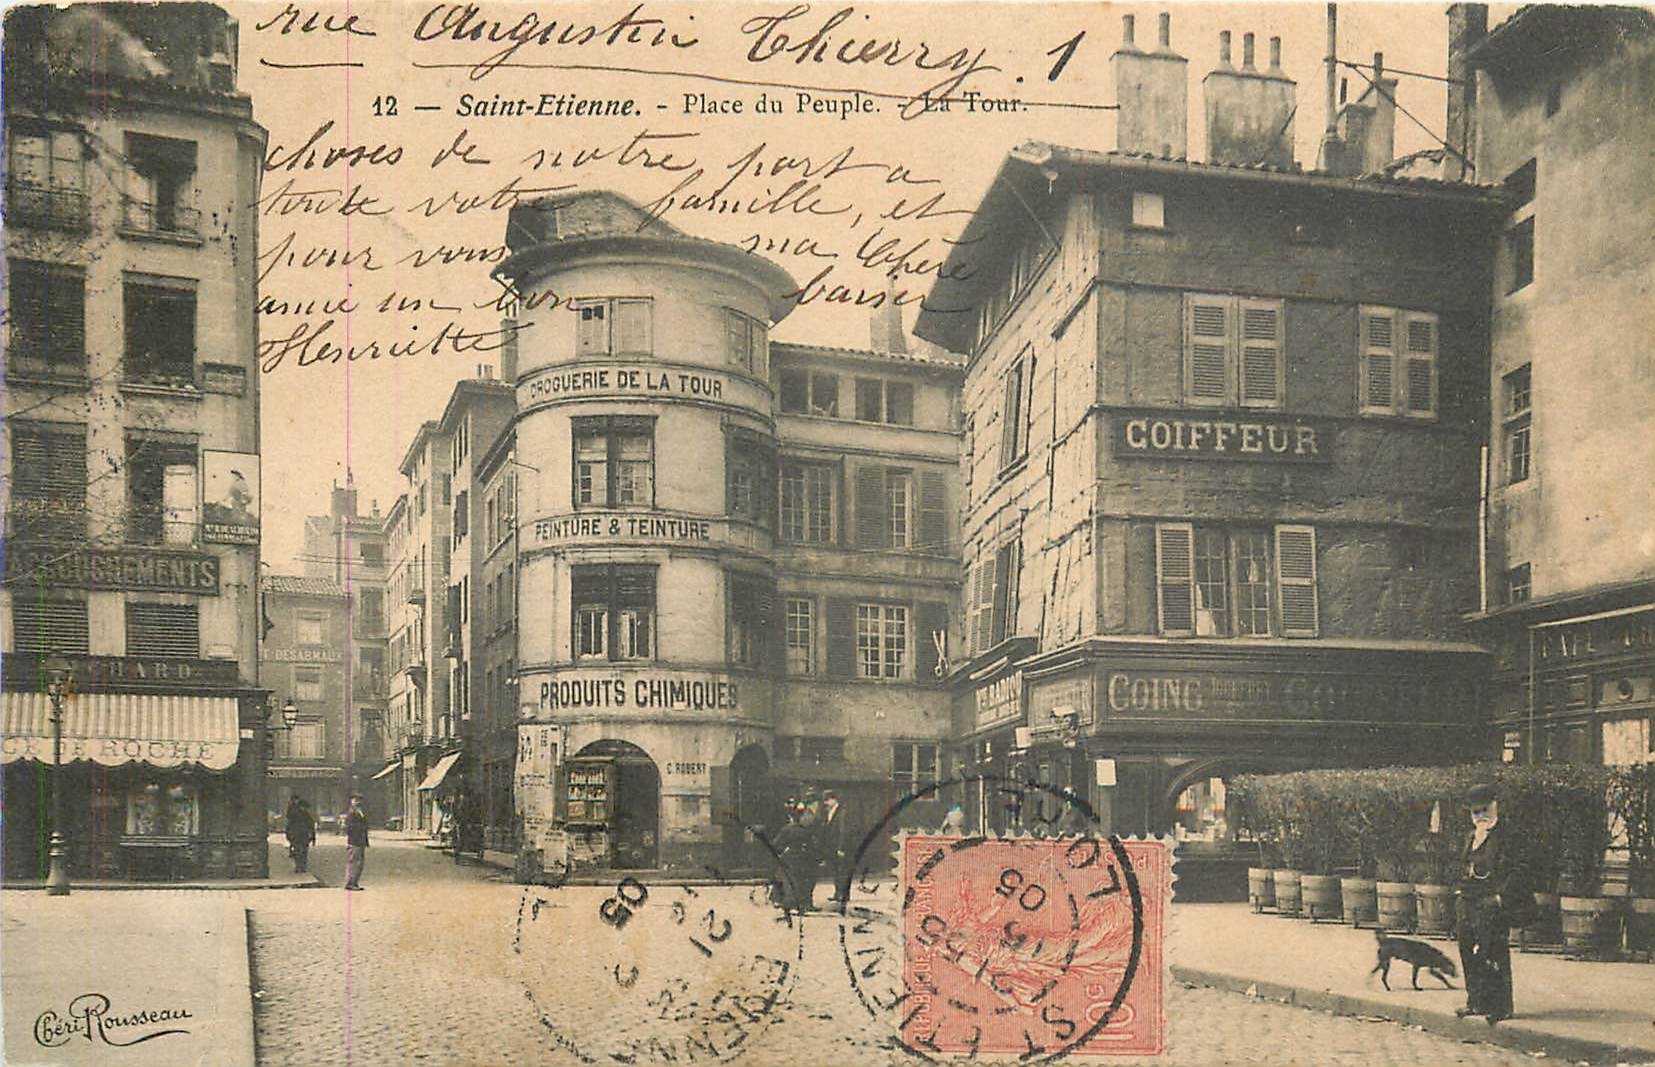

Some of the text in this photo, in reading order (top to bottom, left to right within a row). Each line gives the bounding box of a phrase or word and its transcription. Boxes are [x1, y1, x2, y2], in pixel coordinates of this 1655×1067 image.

[256, 2, 376, 37] rue
[413, 3, 698, 81] Augustin
[265, 120, 404, 172] choses
[432, 129, 491, 169] de
[522, 128, 700, 171] notre
[716, 142, 888, 198] part
[407, 177, 577, 218] votre
[881, 192, 978, 219] et
[253, 231, 383, 286] pour
[400, 243, 512, 269] vous
[741, 233, 839, 259] ma
[255, 283, 363, 315] amie
[377, 292, 462, 313] un
[259, 318, 535, 375] Henriette
[530, 370, 723, 399] DROGUERIE DE LA TOUR
[1125, 419, 1319, 455] COIFFEUR
[535, 518, 711, 541] PEINTURE & TEINTURE
[540, 679, 738, 711] PRODUITS CHIMIQUES
